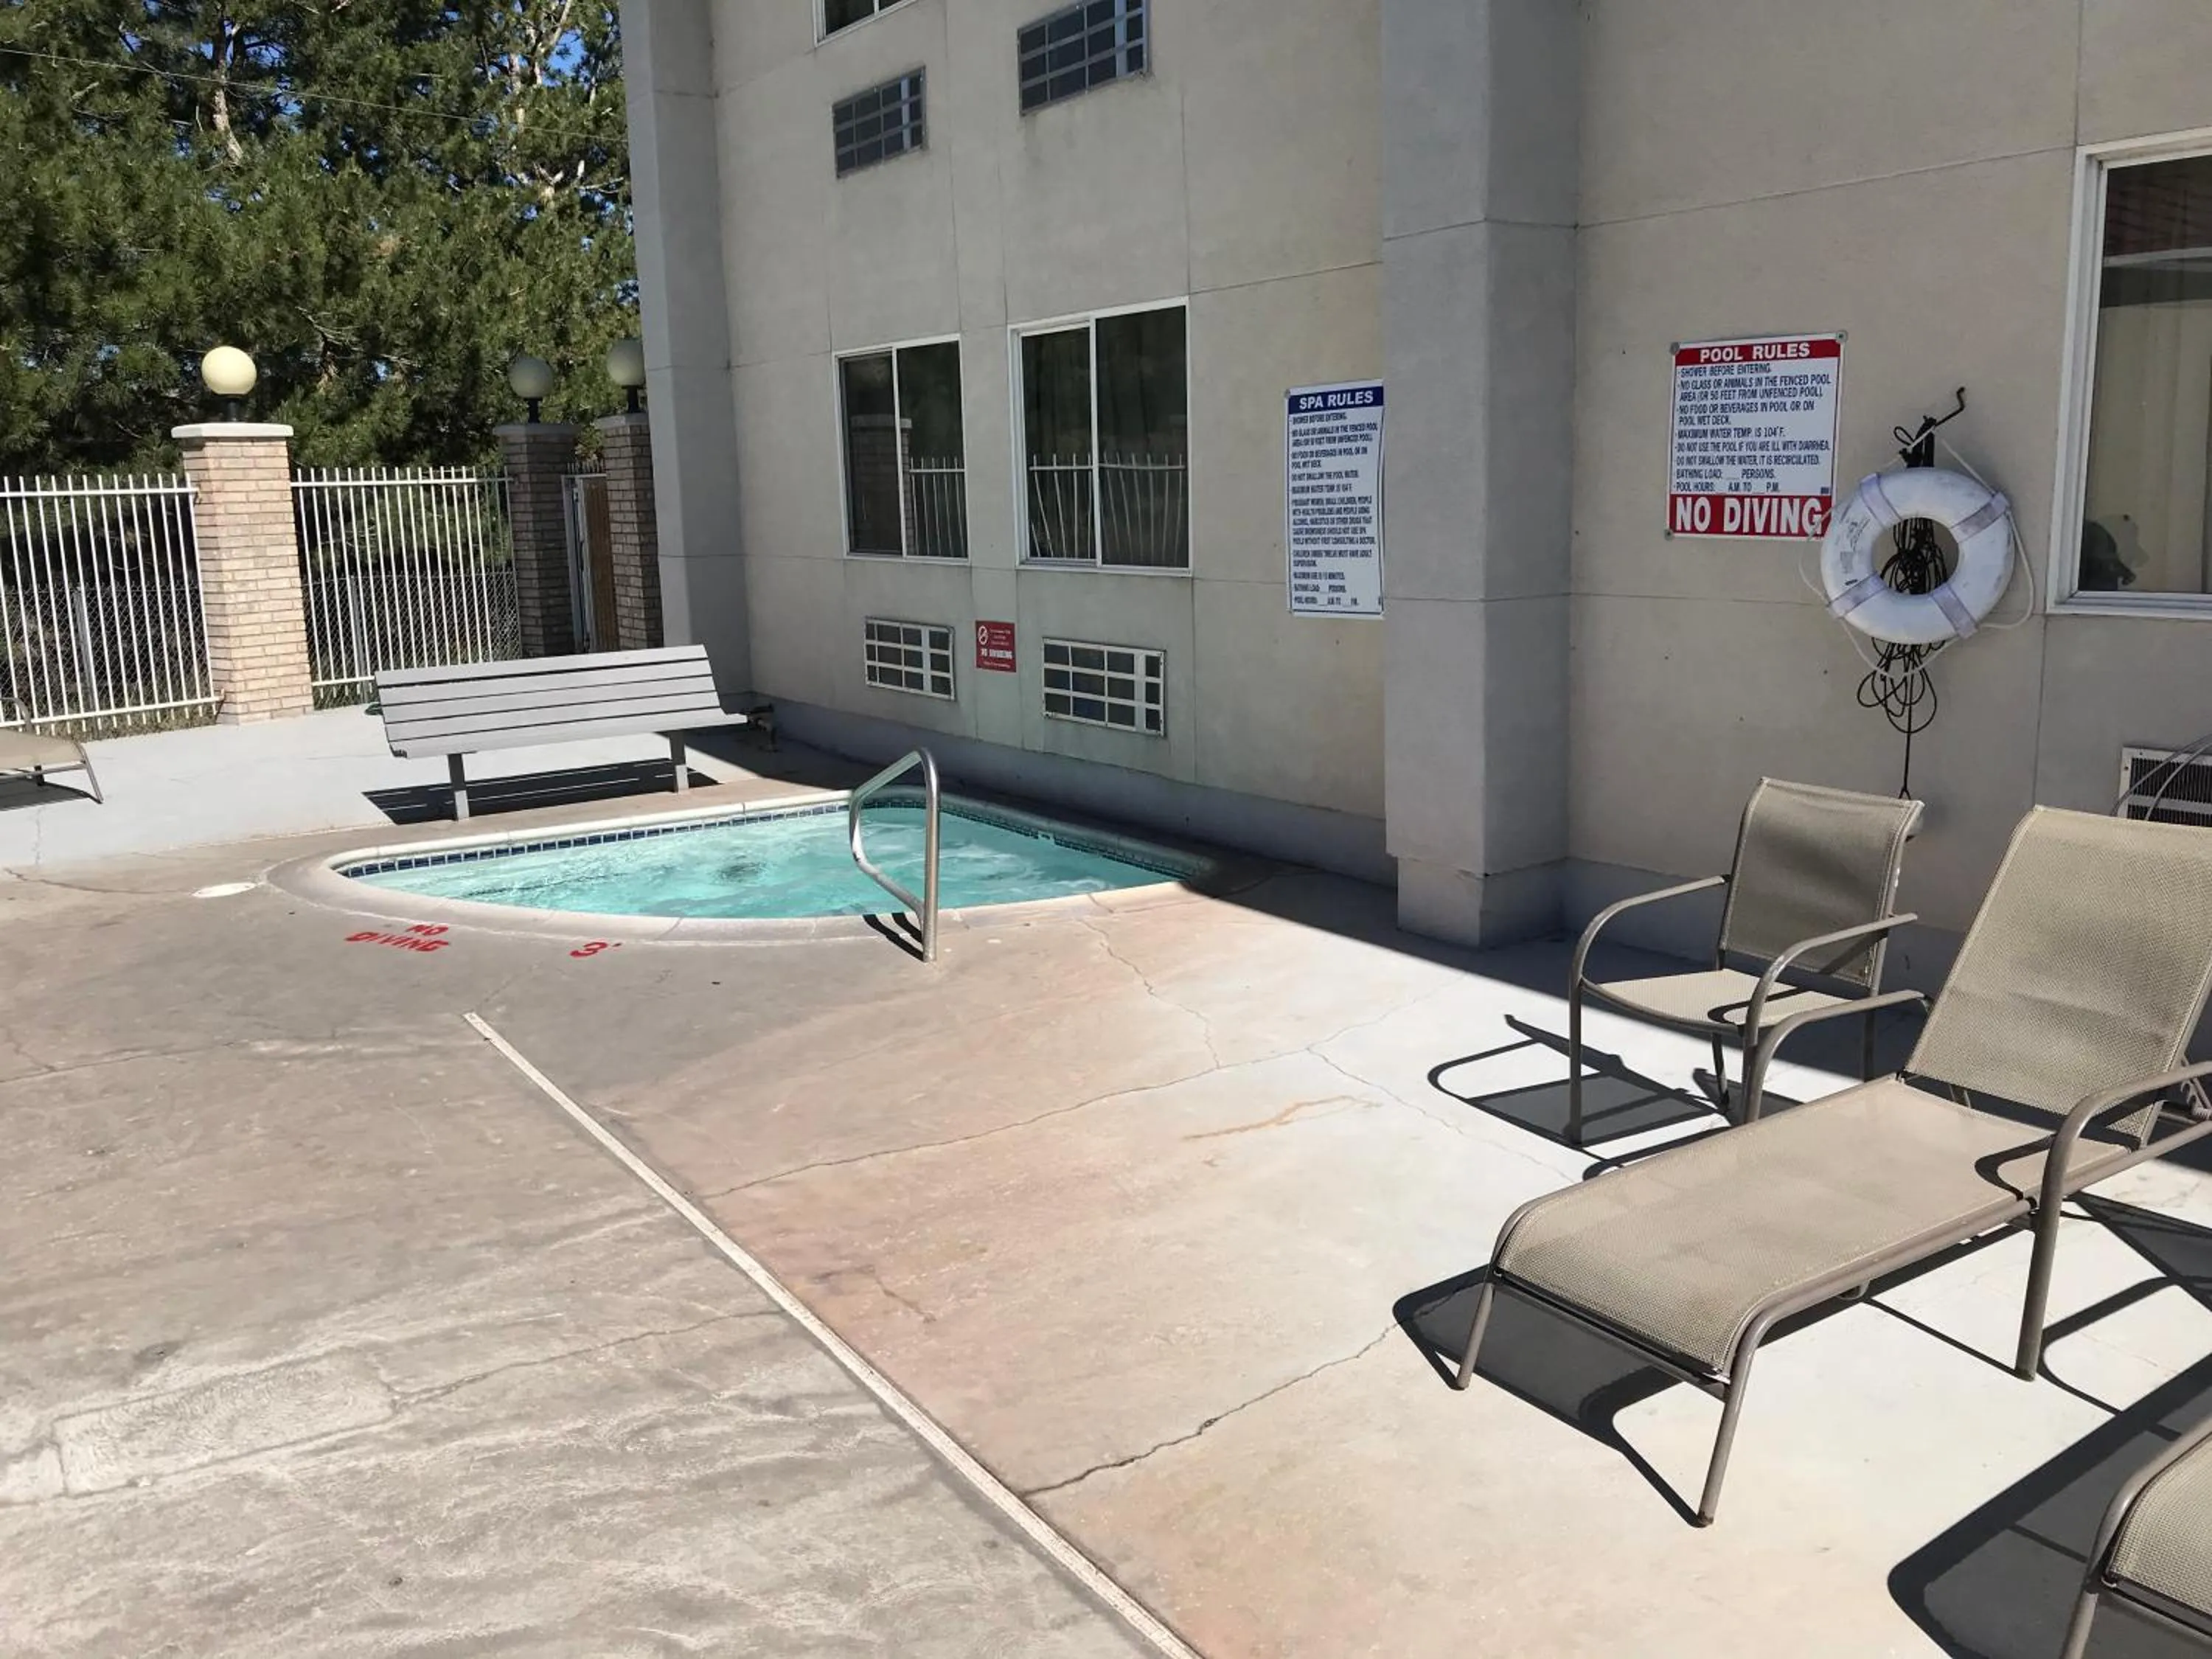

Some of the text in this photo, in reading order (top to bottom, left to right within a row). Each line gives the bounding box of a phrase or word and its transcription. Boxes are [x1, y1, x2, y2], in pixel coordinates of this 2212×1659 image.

[1700, 343, 1810, 362] POOL RULES
[1681, 367, 1706, 378] SHOWER
[1710, 366, 1734, 376] BEFORE
[1681, 374, 1831, 389] NO GLASS OR ANIMALS IN THE FENCED POOL
[1299, 390, 1374, 410] SPA RULES
[1680, 392, 1695, 402] AREA
[1711, 391, 1719, 401] 50
[1720, 389, 1735, 400] FEET
[1738, 389, 1757, 399] FROM
[1759, 387, 1798, 398] UNFENCED
[1679, 400, 1815, 415] NO FOOD OR BEVERAGES IN POOL OR ON
[1679, 415, 1695, 425] POOL
[1697, 415, 1711, 425] WET
[1678, 429, 1708, 439] MAXIMUM
[1710, 428, 1731, 439] WATER
[1755, 428, 1761, 437] IS
[1676, 496, 1711, 532] NO
[1723, 497, 1823, 535] DIVING
[407, 925, 449, 936] NO
[345, 931, 449, 952] DIVING
